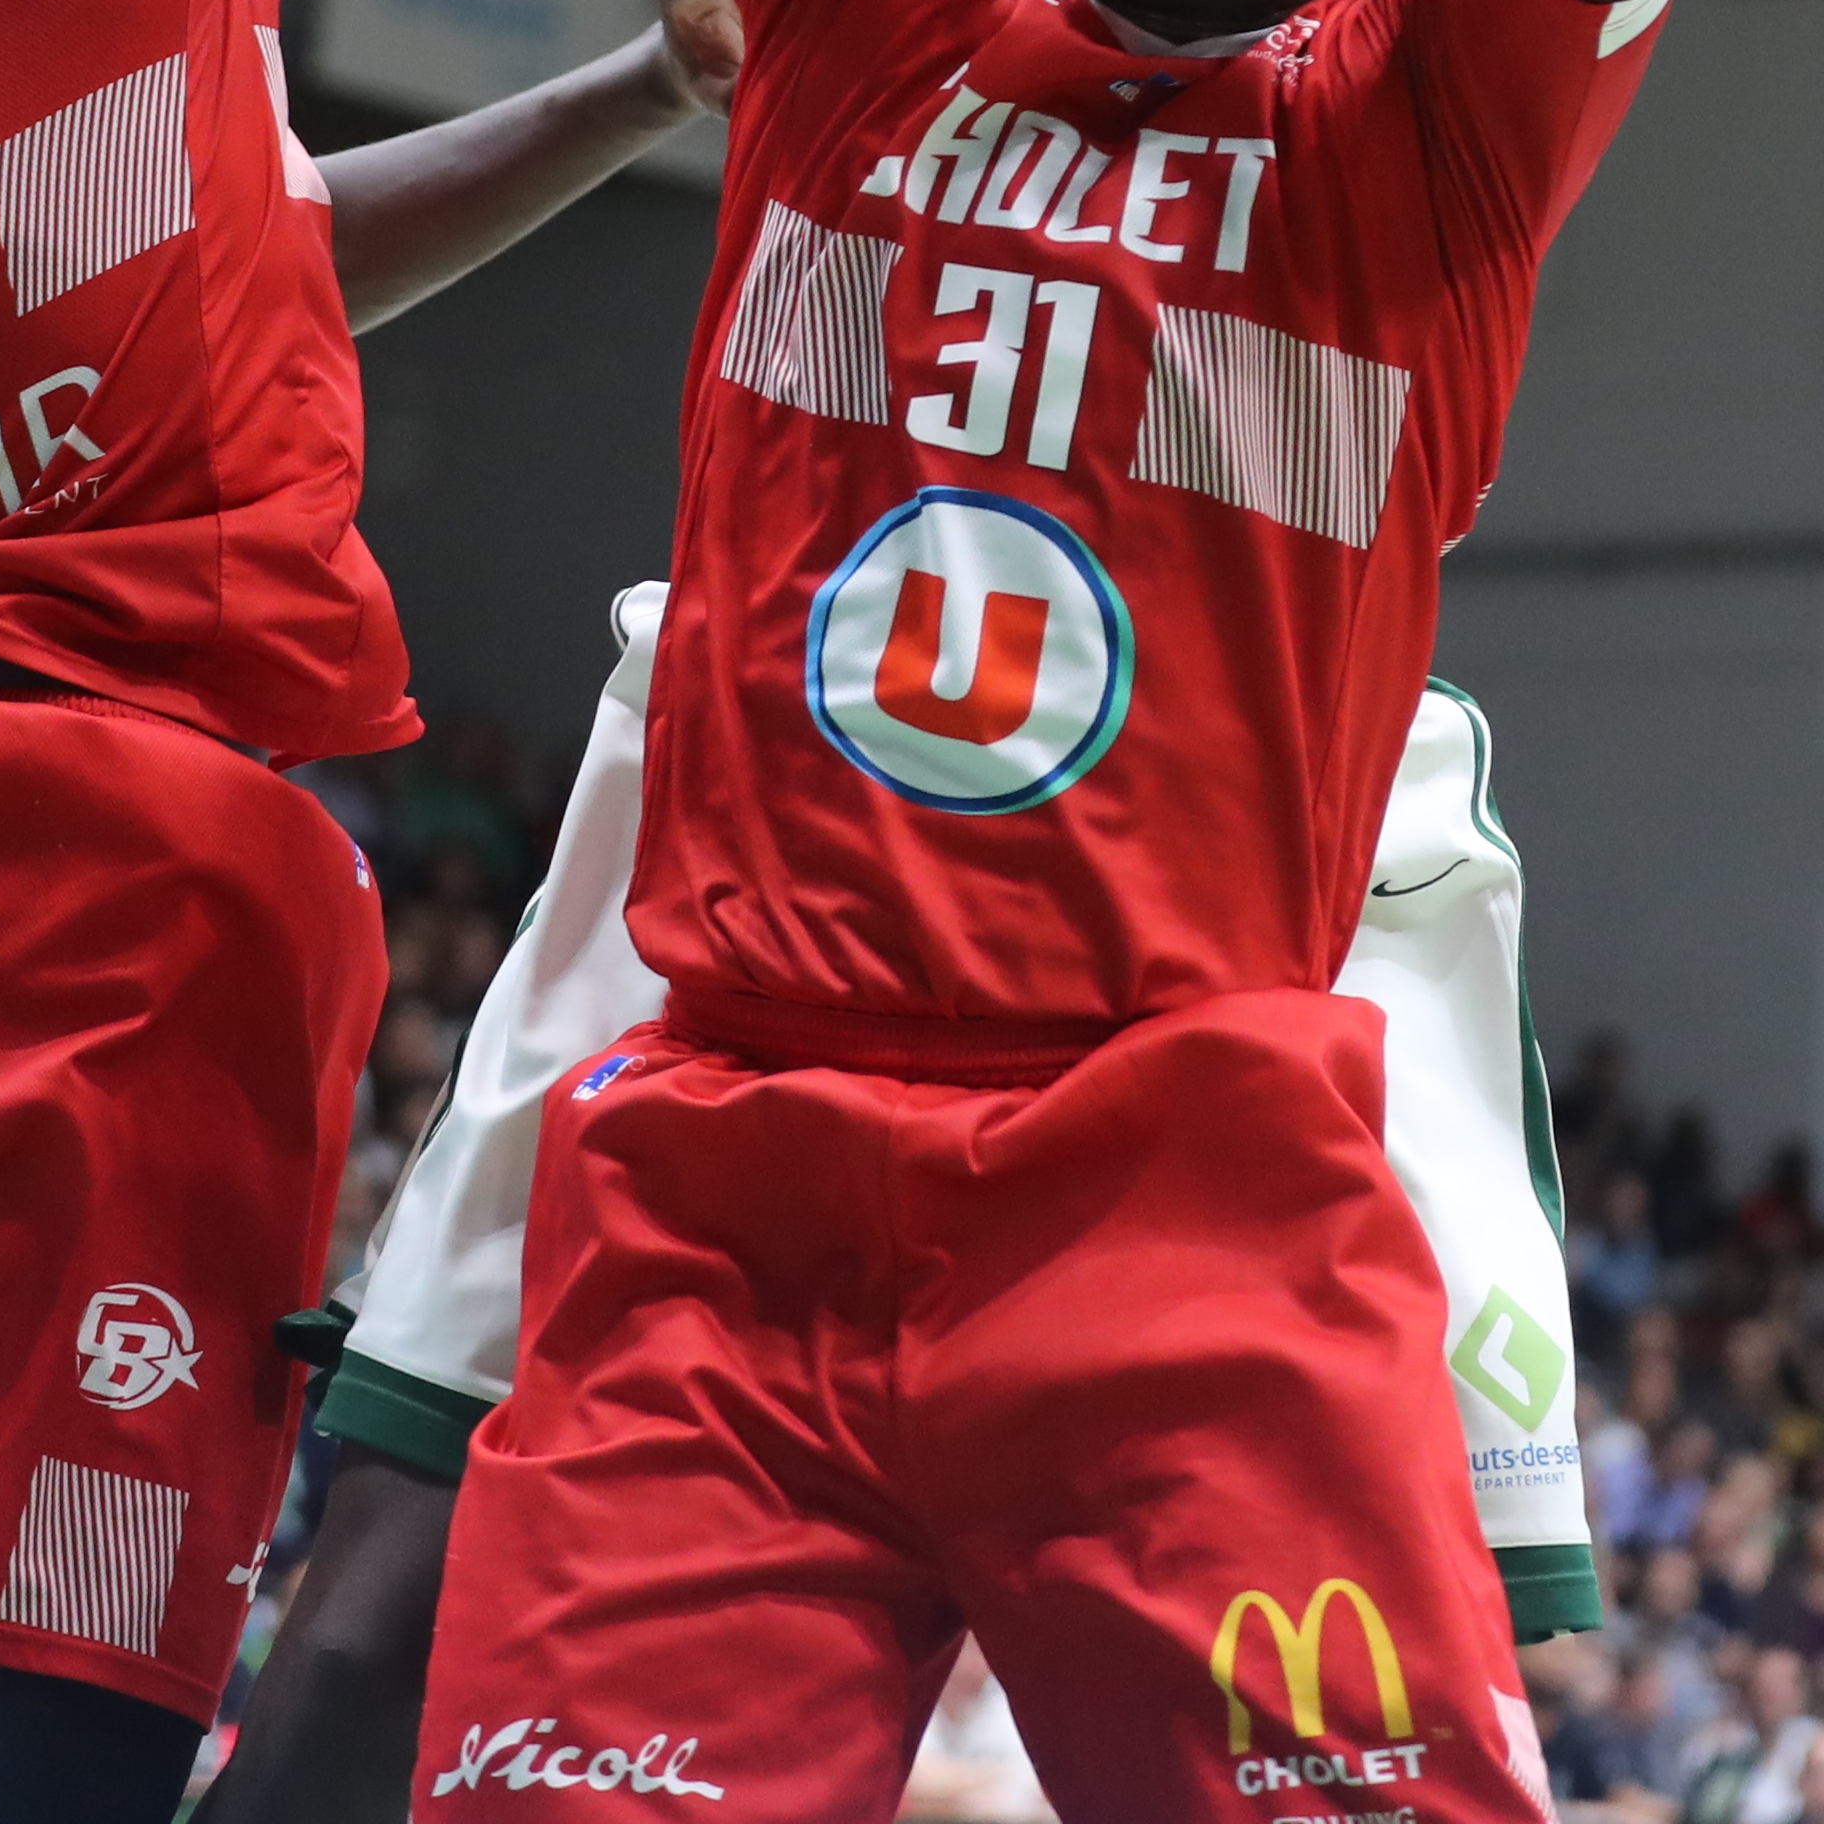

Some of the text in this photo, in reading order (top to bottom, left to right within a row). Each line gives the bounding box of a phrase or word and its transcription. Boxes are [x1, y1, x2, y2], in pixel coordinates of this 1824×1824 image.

[906, 264, 1099, 471] 31
[1474, 1472, 1566, 1492] ÉPARTEMENT
[431, 1718, 725, 1801] Nicoll
[1236, 1743, 1428, 1797] CHOLET
